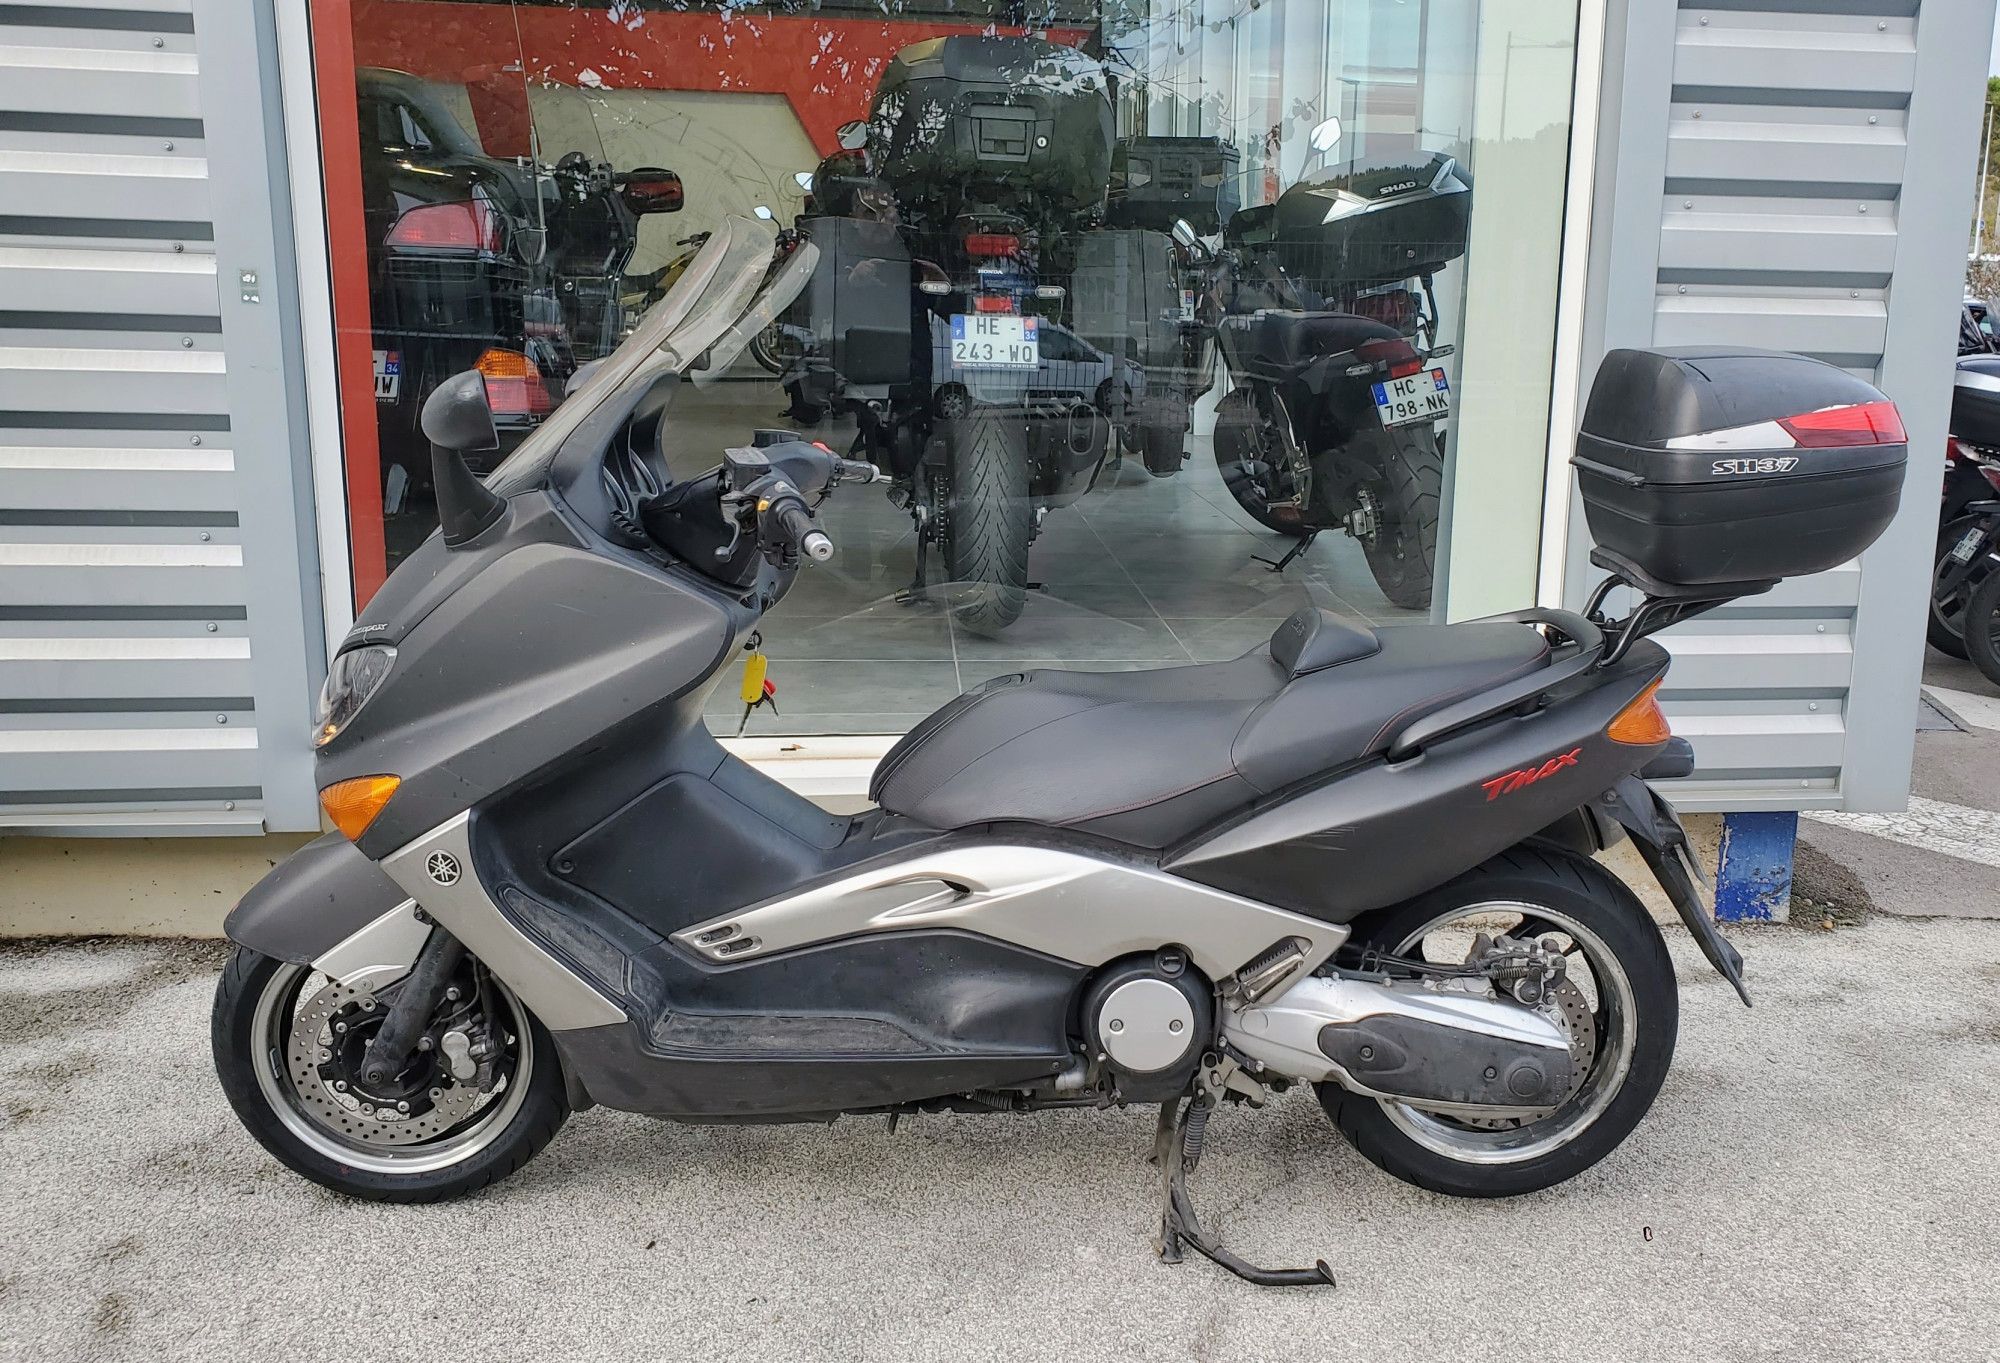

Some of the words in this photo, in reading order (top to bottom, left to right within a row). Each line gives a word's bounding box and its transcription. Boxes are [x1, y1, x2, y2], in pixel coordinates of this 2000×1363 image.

[1379, 181, 1417, 195] SHAD
[976, 317, 1000, 335] HE
[1025, 331, 1036, 340] 34
[386, 363, 398, 373] 34
[1393, 379, 1416, 397] HC
[1435, 380, 1446, 389] 34
[1712, 457, 1799, 476] SH37
[1481, 747, 1583, 802] TMAX
